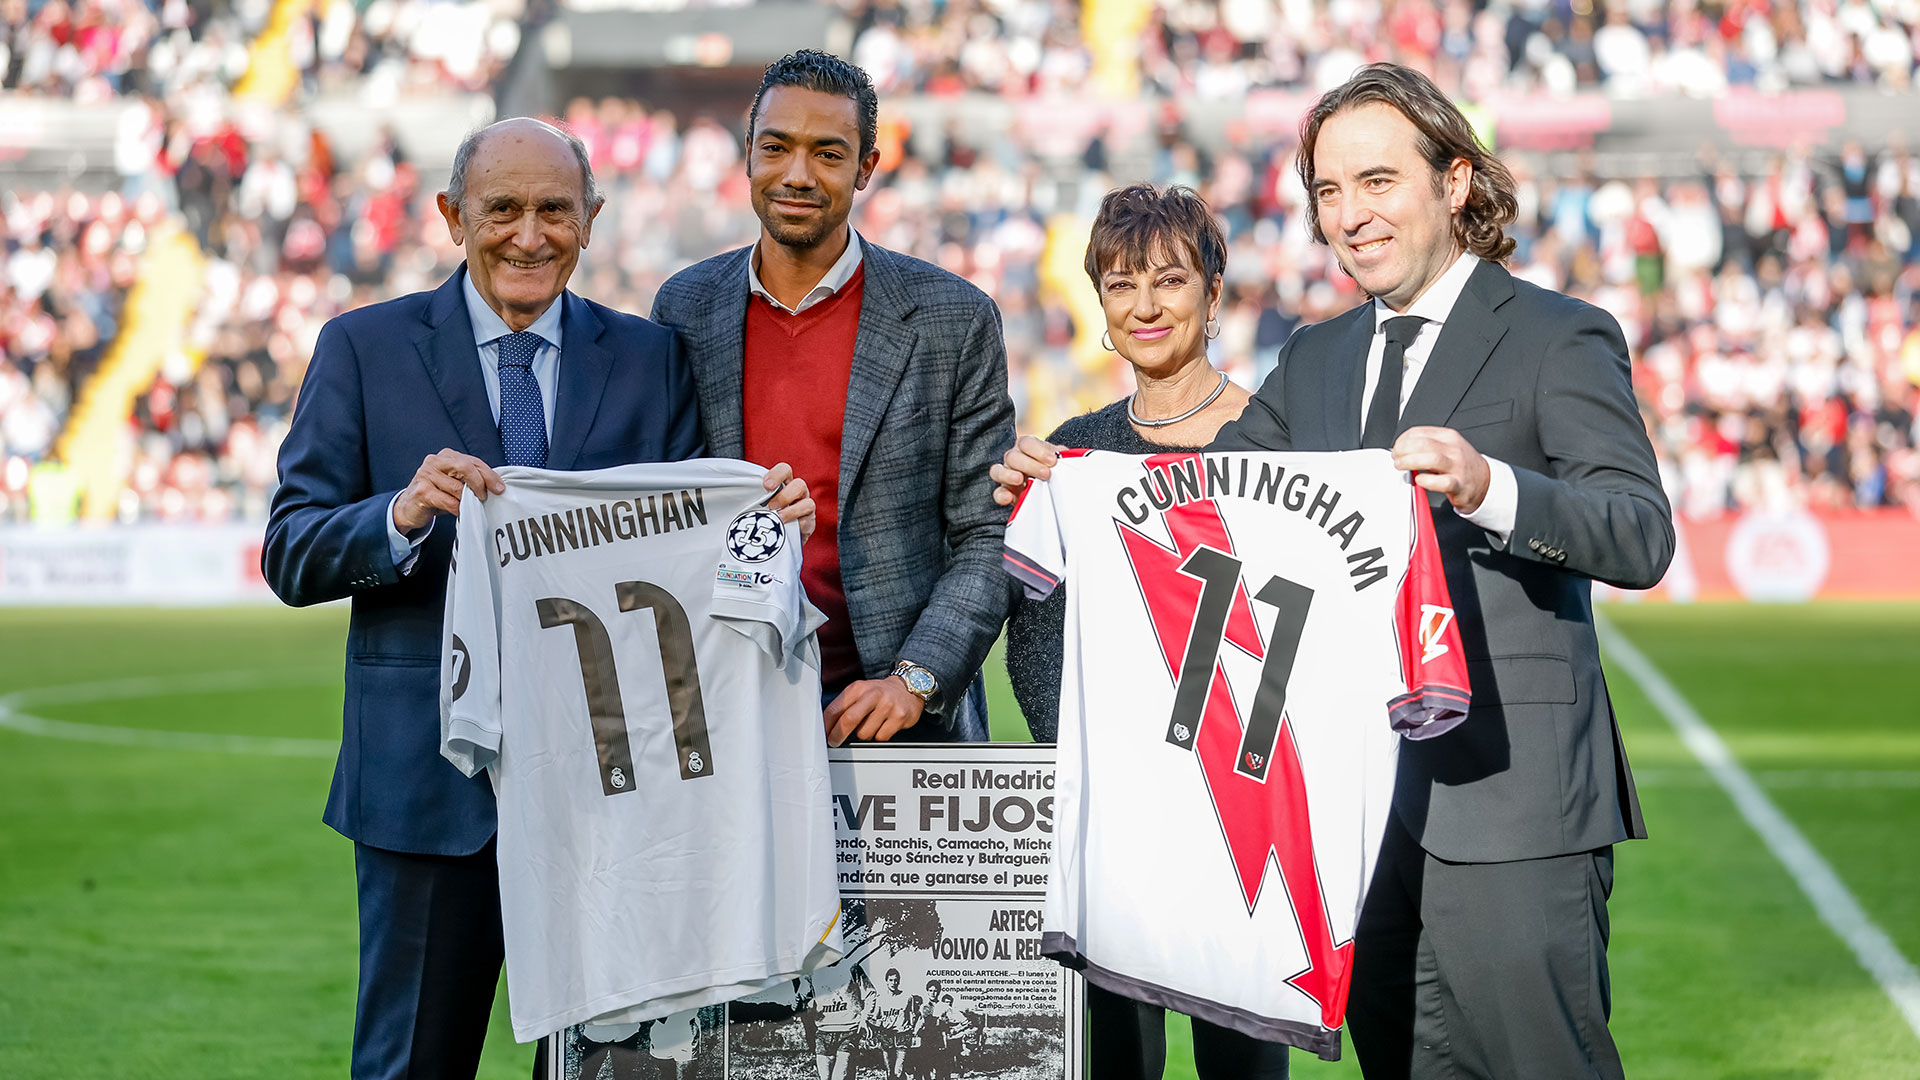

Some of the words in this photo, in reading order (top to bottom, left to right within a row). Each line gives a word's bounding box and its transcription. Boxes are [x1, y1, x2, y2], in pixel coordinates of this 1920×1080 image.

[495, 488, 708, 567] CUNNINGHAN
[739, 524, 771, 547] 15
[1116, 457, 1388, 592] CUNNINGHAM
[717, 571, 752, 581] FOUNDATION
[1165, 547, 1314, 781] 11
[536, 580, 714, 796] 11
[912, 769, 965, 789] Real
[972, 769, 1056, 790] Madrid
[832, 795, 896, 831] VE
[919, 796, 1054, 833] FIJOS
[875, 837, 932, 851] Sanchis,
[937, 838, 1009, 852] Camacho,
[866, 852, 902, 866] Hugo
[906, 852, 964, 864] Sánchez
[967, 855, 975, 867] y
[838, 870, 885, 884] ndrán
[890, 873, 920, 886] que
[925, 873, 988, 887] ganarse
[993, 871, 1008, 885] el
[932, 938, 989, 960] VOLVIO
[992, 938, 1012, 960] AL
